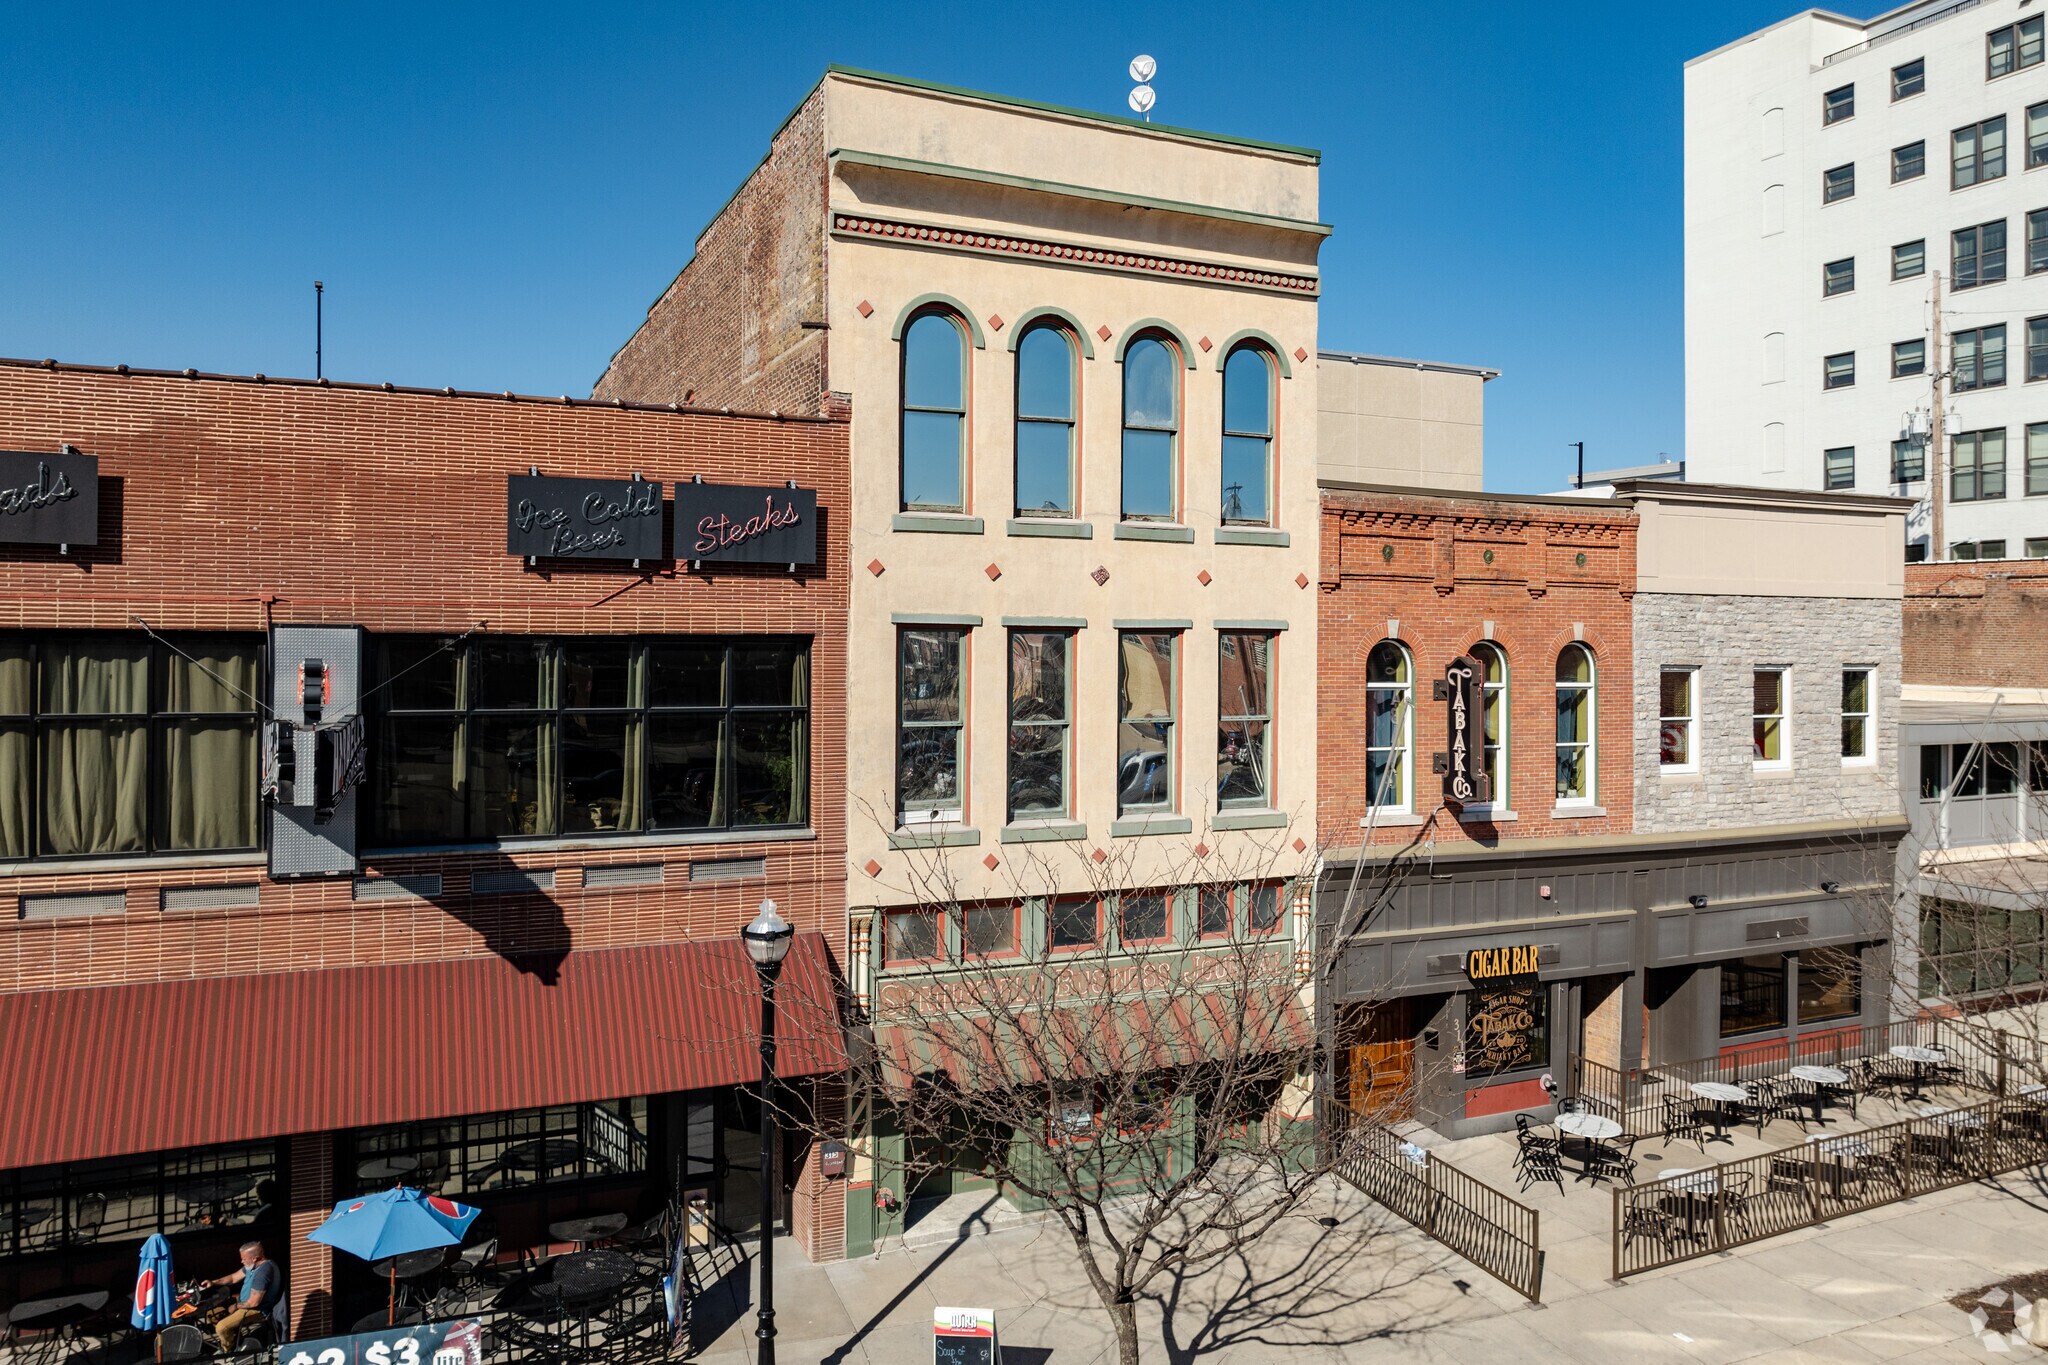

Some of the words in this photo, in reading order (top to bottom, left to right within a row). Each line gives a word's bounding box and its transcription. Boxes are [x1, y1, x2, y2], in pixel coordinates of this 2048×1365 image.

[516, 499, 568, 528] Ice
[582, 484, 655, 520] Cold
[695, 496, 799, 552] Steaks
[551, 524, 622, 553] Beer
[1470, 947, 1510, 979] CIGAR
[1511, 945, 1539, 975] BAR
[879, 972, 1046, 1016] SPRINGFELD
[1055, 962, 1170, 998] BUSNESS
[937, 1339, 956, 1359] Soup
